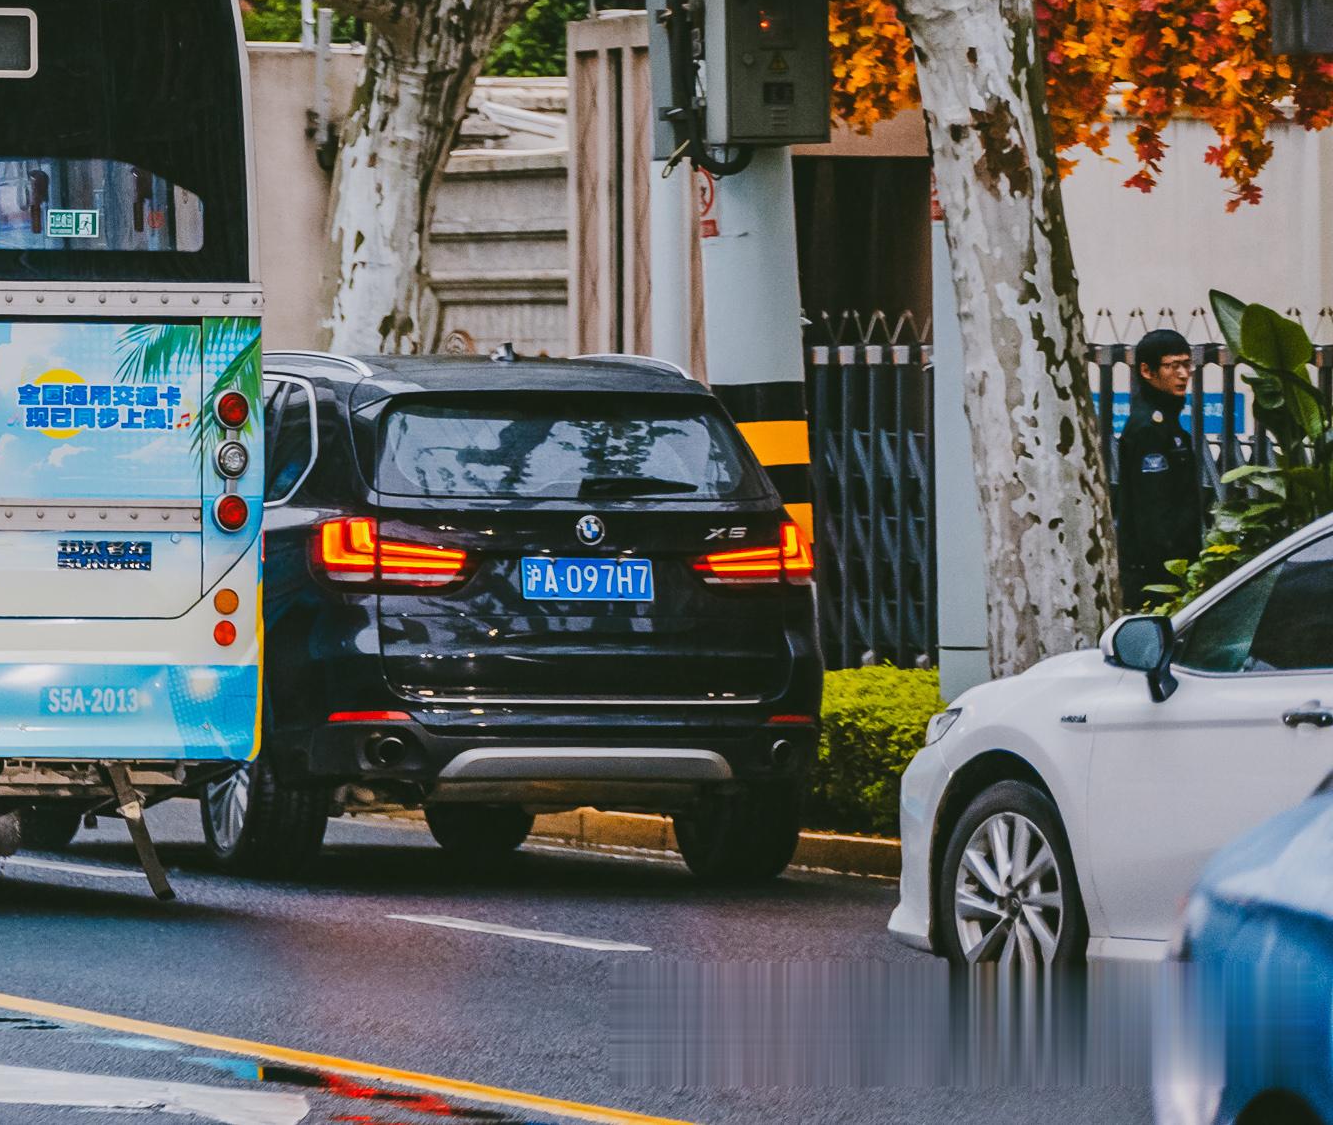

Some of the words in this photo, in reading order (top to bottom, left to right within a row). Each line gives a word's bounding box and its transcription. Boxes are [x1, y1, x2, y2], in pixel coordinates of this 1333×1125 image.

[18, 384, 181, 406] 全国通用交通卡
[48, 687, 139, 713] S5A-2013
